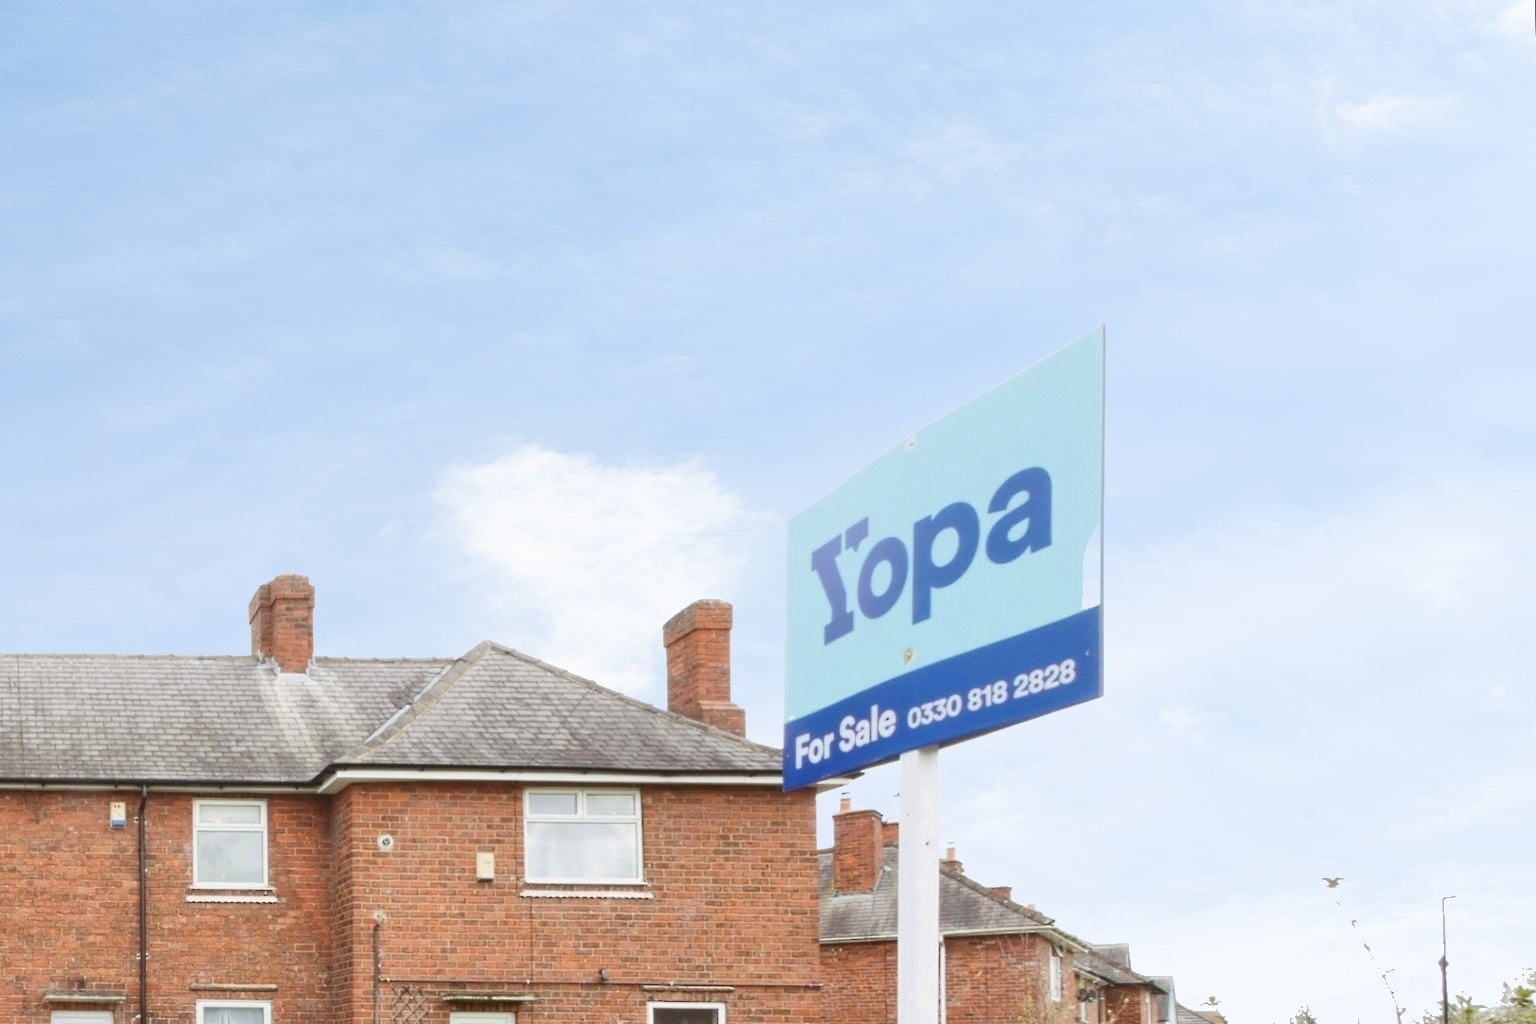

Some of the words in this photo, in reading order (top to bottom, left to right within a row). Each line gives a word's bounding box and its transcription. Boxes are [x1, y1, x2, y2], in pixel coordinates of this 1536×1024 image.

[810, 466, 1053, 646] Yopa
[795, 732, 835, 770] For
[838, 703, 897, 753] Sale
[906, 693, 963, 730] 0330
[966, 679, 1008, 712] 818
[1012, 658, 1077, 700] 2828
